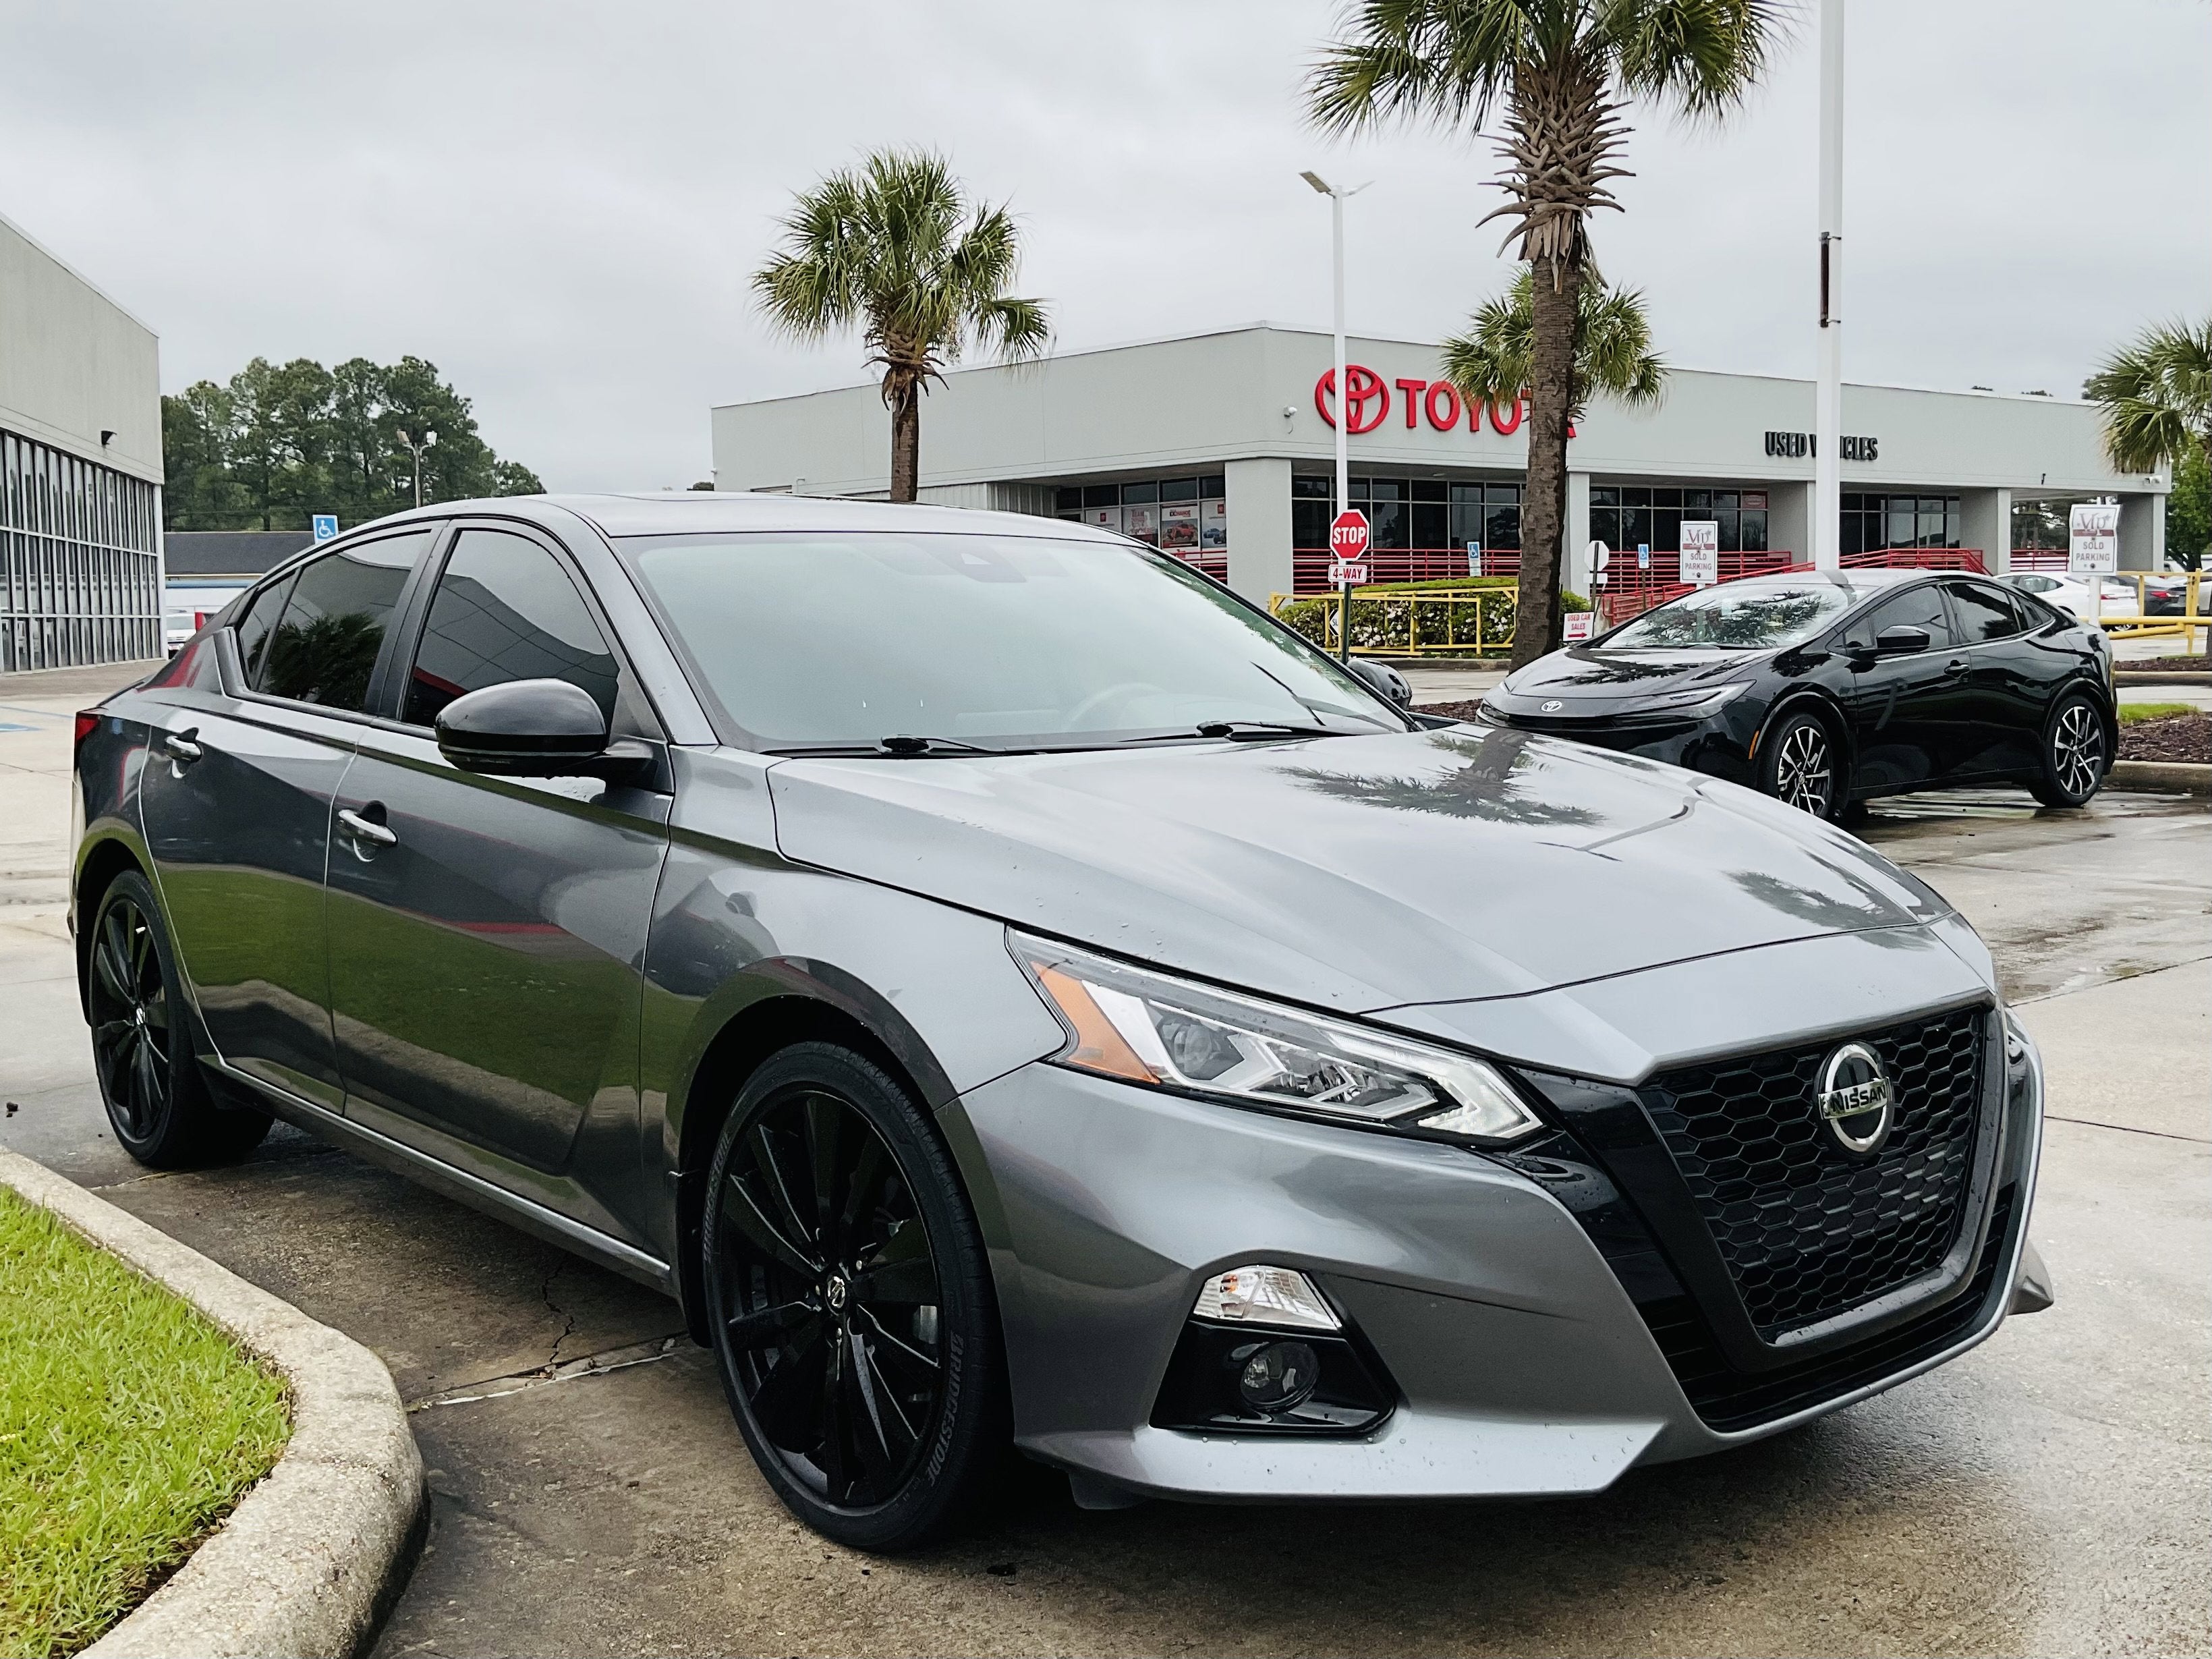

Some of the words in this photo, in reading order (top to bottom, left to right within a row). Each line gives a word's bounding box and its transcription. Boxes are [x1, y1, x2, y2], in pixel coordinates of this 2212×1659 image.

[1396, 378, 1577, 439] TOYO
[1765, 431, 1807, 457] USED
[1333, 526, 1367, 544] STOP
[2083, 541, 2104, 550] SOLD
[1690, 553, 1707, 561] SOLD
[2076, 553, 2110, 561] PARKING
[1333, 568, 1363, 580] 4-WAY
[1685, 563, 1712, 571] PARKING
[1831, 1086, 1887, 1112] NISSAN
[926, 1329, 965, 1488] BRIDGESTONE
